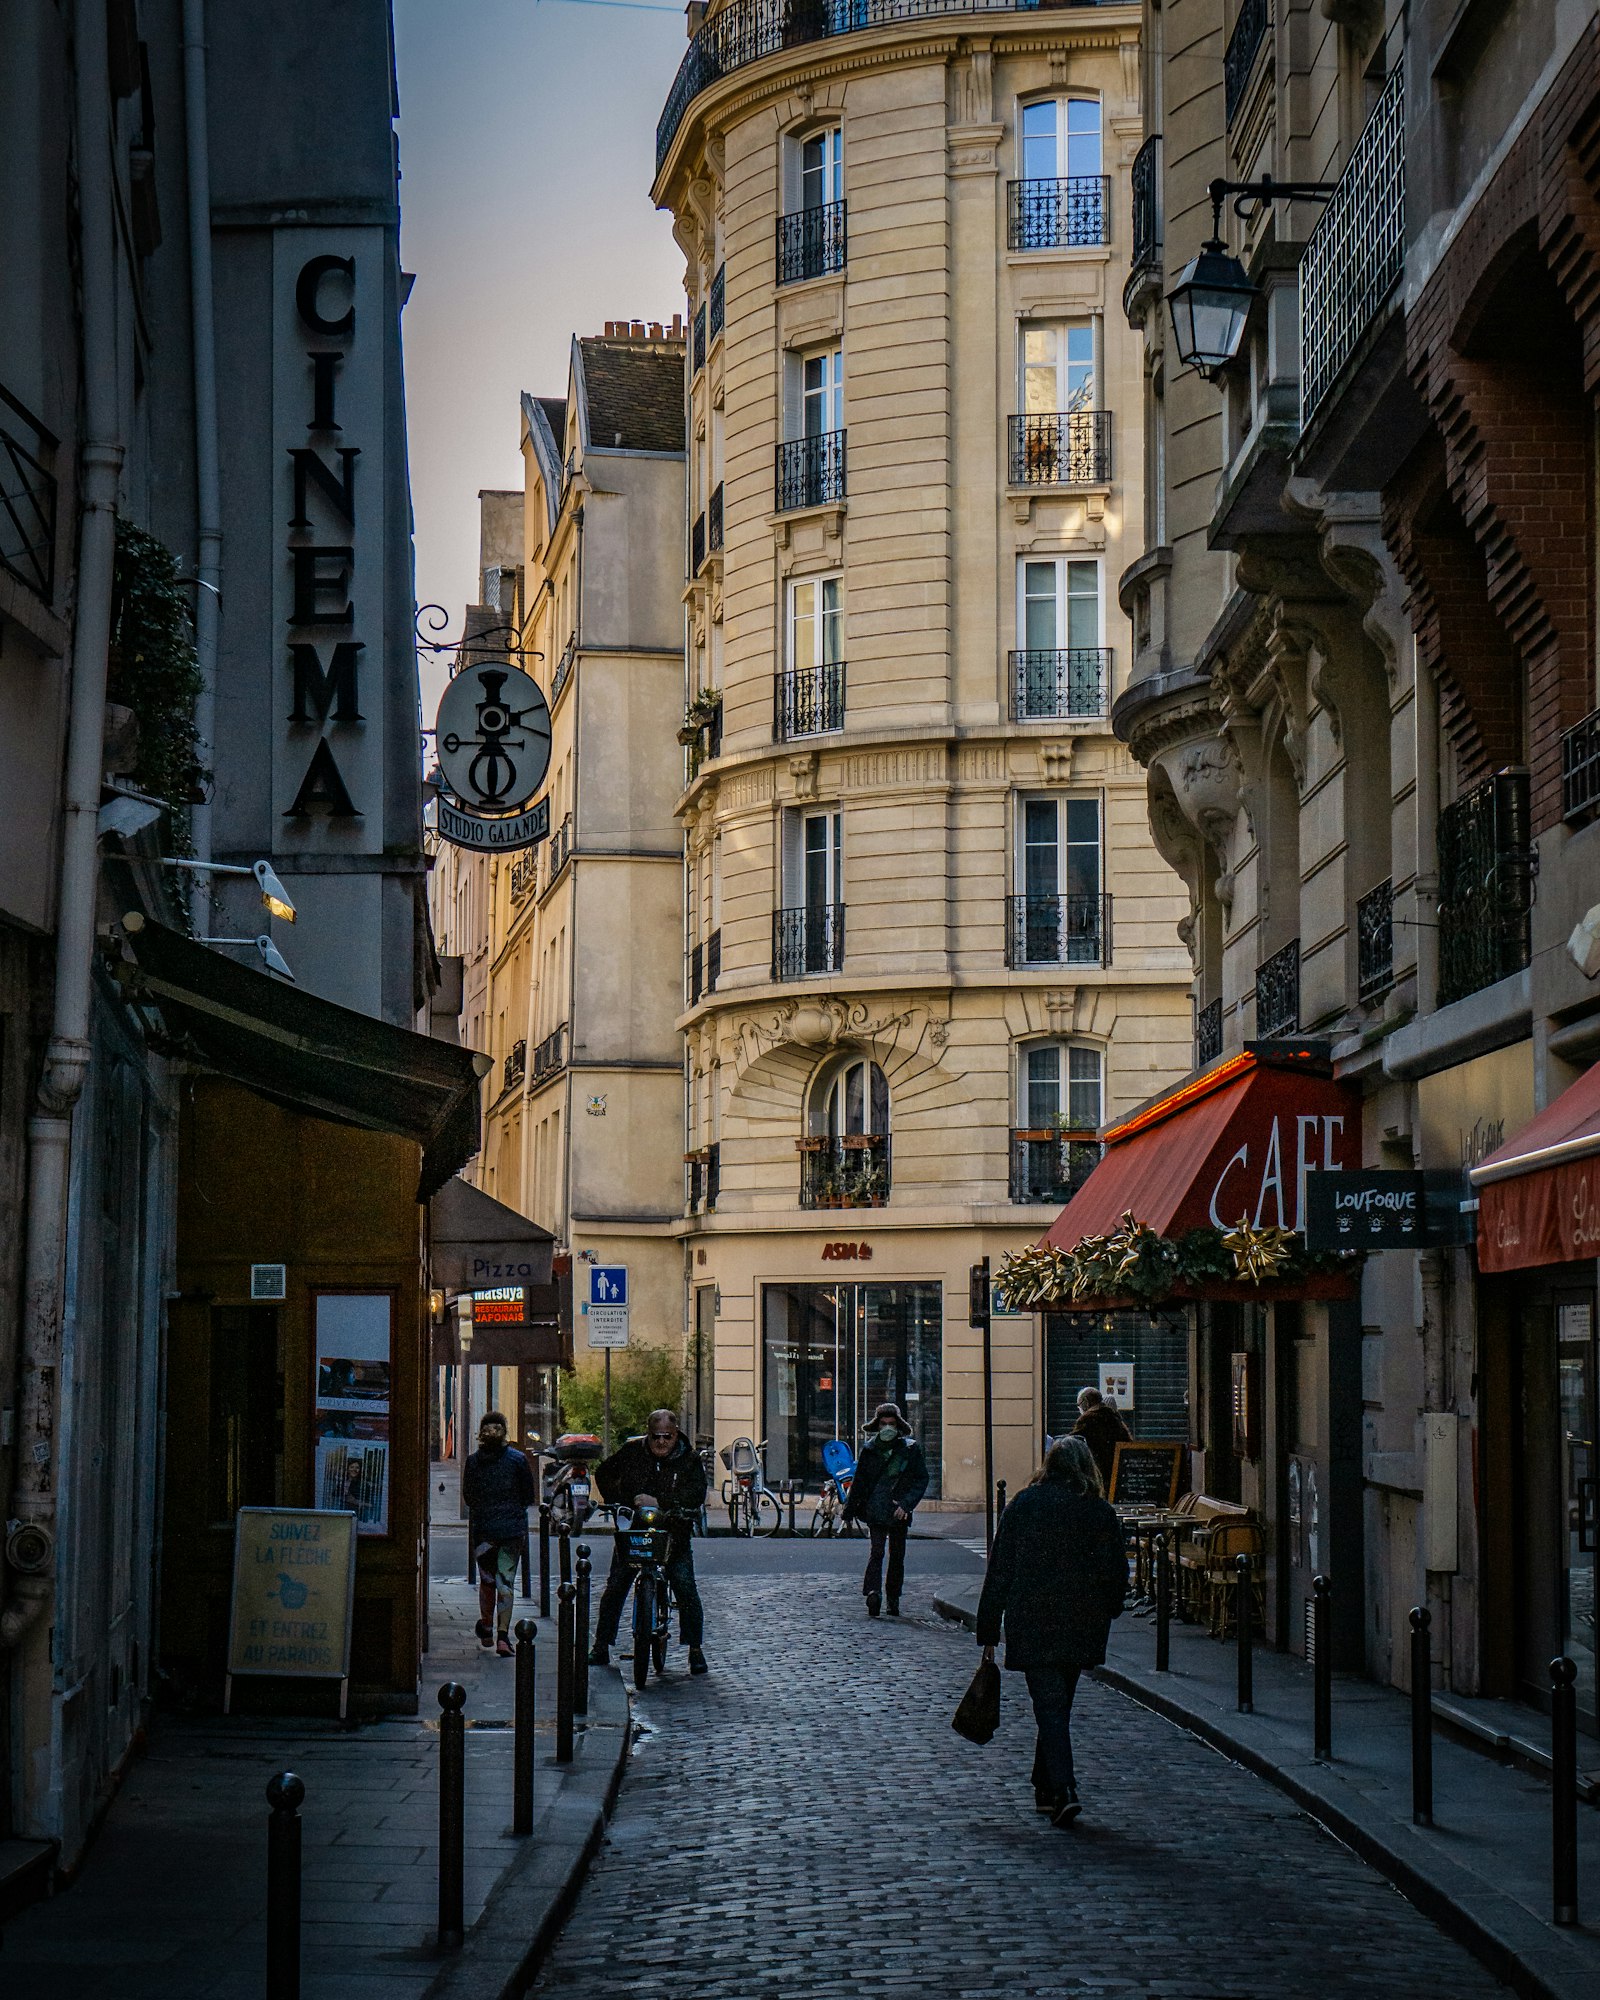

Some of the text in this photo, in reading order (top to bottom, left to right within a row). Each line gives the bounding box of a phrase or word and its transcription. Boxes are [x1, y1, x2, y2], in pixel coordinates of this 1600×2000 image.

[282, 254, 366, 817] CINEMA
[441, 806, 545, 842] STUDIO GALANDE
[474, 1259, 531, 1277] Pizza
[475, 1305, 524, 1313] RESTAURANT
[319, 1398, 347, 1407] DRIVE
[269, 1523, 321, 1542] SUIVEZ
[255, 1548, 274, 1564] LA
[272, 1621, 328, 1640] ENTREZ
[244, 1644, 332, 1666] AU PARADIS
